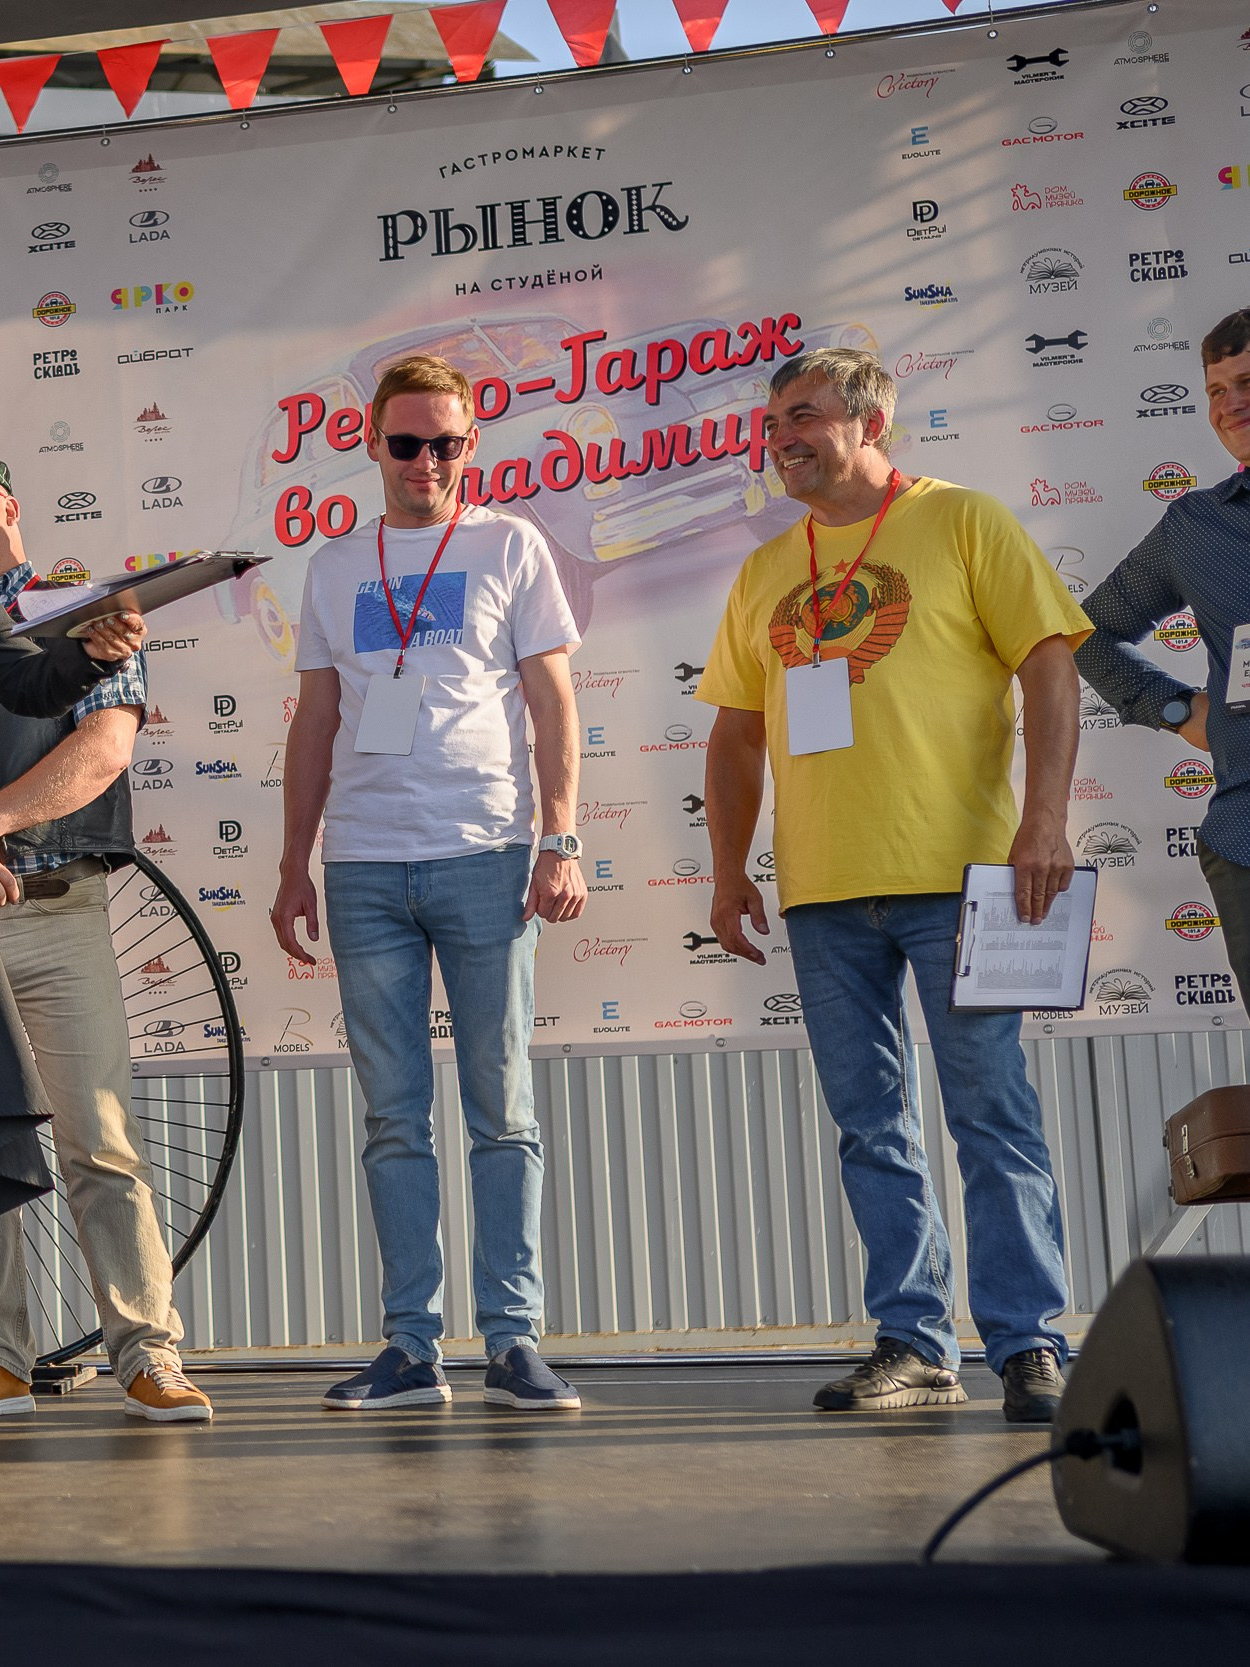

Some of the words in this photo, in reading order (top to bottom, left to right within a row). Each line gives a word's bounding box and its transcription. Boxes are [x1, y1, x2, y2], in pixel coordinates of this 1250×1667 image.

[1114, 53, 1169, 65] ATMOSPHERE
[876, 72, 939, 98] Victory
[1116, 115, 1176, 130] XCITE
[1002, 136, 1031, 146] GAC
[1032, 132, 1084, 143] MOTOR
[902, 149, 941, 160] EVOLUTE
[438, 145, 607, 179] ГАСТРОМАРКЕТ
[377, 181, 690, 262] РЫНОК
[129, 230, 170, 243] LADA
[28, 240, 76, 253] XCITE
[455, 281, 482, 296] НА
[490, 264, 604, 292] СТУДЁНОЙ
[1029, 278, 1078, 294] МУЗЕЙ
[110, 281, 194, 310] ЯРКО
[156, 304, 188, 314] ПАРК
[1133, 340, 1190, 352] ATMOSPHERE
[895, 352, 958, 380] Victory
[271, 312, 804, 464] Рео-Гараж
[1136, 405, 1196, 418] XCITE
[1020, 425, 1050, 433] GAC
[1051, 419, 1104, 431] MOTOR
[920, 433, 960, 442] EVOLUTE
[39, 442, 84, 453] ATMOSPHERE
[142, 497, 183, 510] LADA
[54, 510, 102, 523] XCITE
[274, 485, 359, 548] во
[357, 580, 379, 594] GET
[410, 632, 421, 648] A
[423, 628, 464, 646] BOAT
[1159, 630, 1197, 638] ДОРОЖНО
[640, 744, 667, 752] GAC
[669, 741, 708, 750] MOTO
[132, 779, 174, 791] LADA
[260, 774, 284, 788] MOD
[1166, 827, 1199, 842] РЕТ
[1085, 854, 1135, 868] МУЗЕЙ
[648, 878, 675, 887] GAC
[676, 876, 715, 886] MOTO
[139, 906, 180, 917] LADA
[573, 937, 632, 967] Victory
[1099, 1001, 1149, 1015] МУЗЕЙ
[760, 1016, 805, 1026] XCIT
[1032, 1010, 1074, 1020] MODELS
[593, 1026, 631, 1034] EVOLUTE
[654, 1020, 682, 1029] GAC
[683, 1018, 733, 1028] MOTOR
[144, 1041, 186, 1053] LADA
[274, 1043, 310, 1053] MODELS
